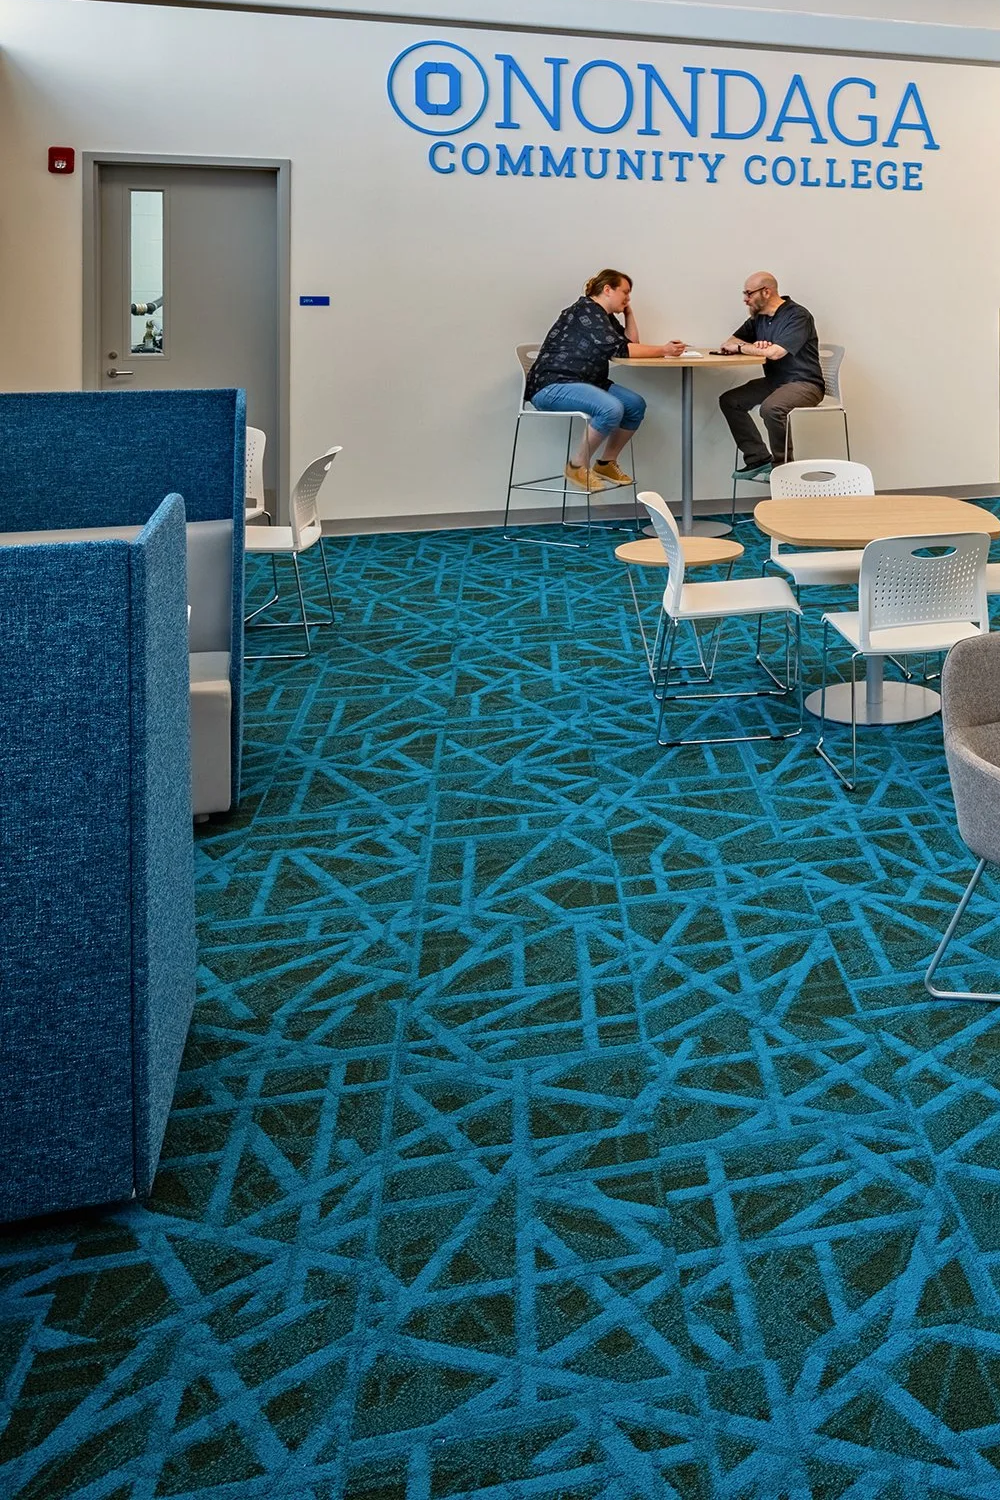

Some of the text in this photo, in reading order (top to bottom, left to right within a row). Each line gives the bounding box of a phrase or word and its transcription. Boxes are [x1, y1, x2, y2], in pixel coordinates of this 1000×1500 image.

[387, 40, 940, 151] ONONDAGA
[428, 141, 923, 191] COMMUNITY COLLEGE
